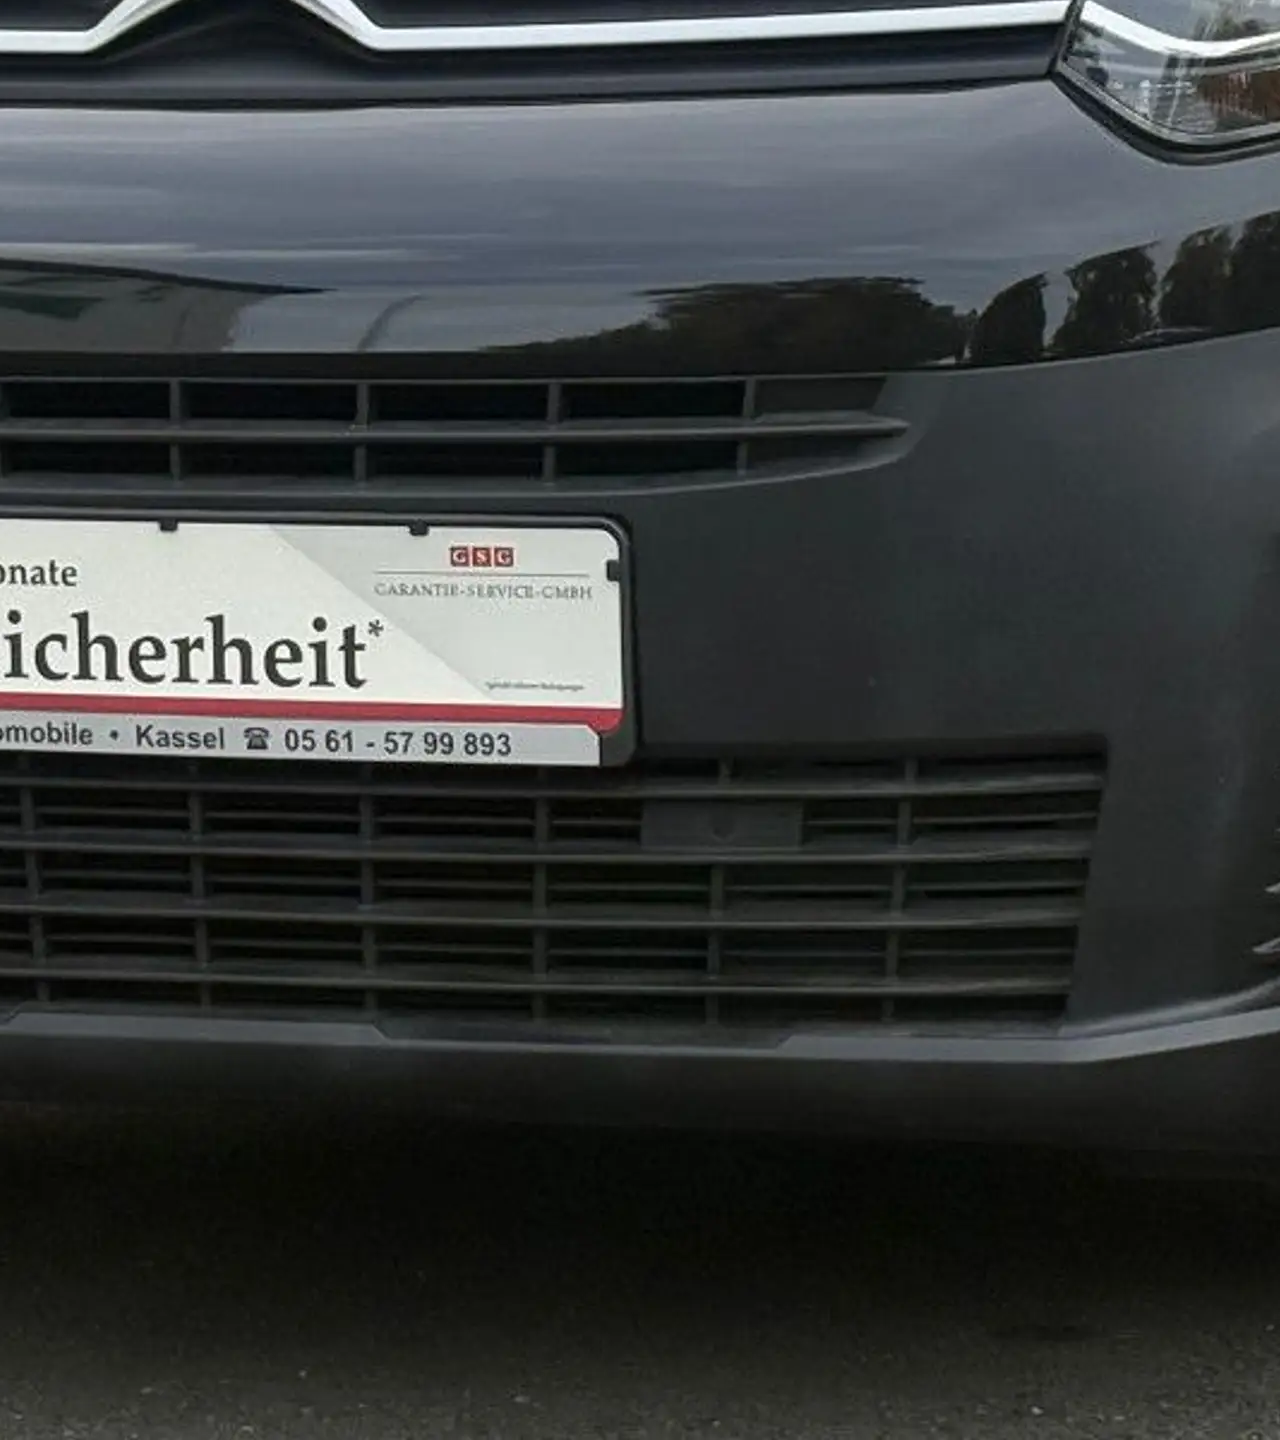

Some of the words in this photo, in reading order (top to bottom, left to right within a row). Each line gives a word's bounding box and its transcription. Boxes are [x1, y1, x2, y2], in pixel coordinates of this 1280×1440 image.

[135, 724, 225, 750] Kassel
[384, 730, 414, 755] 57
[423, 731, 455, 755] 99
[463, 732, 512, 757] 893
